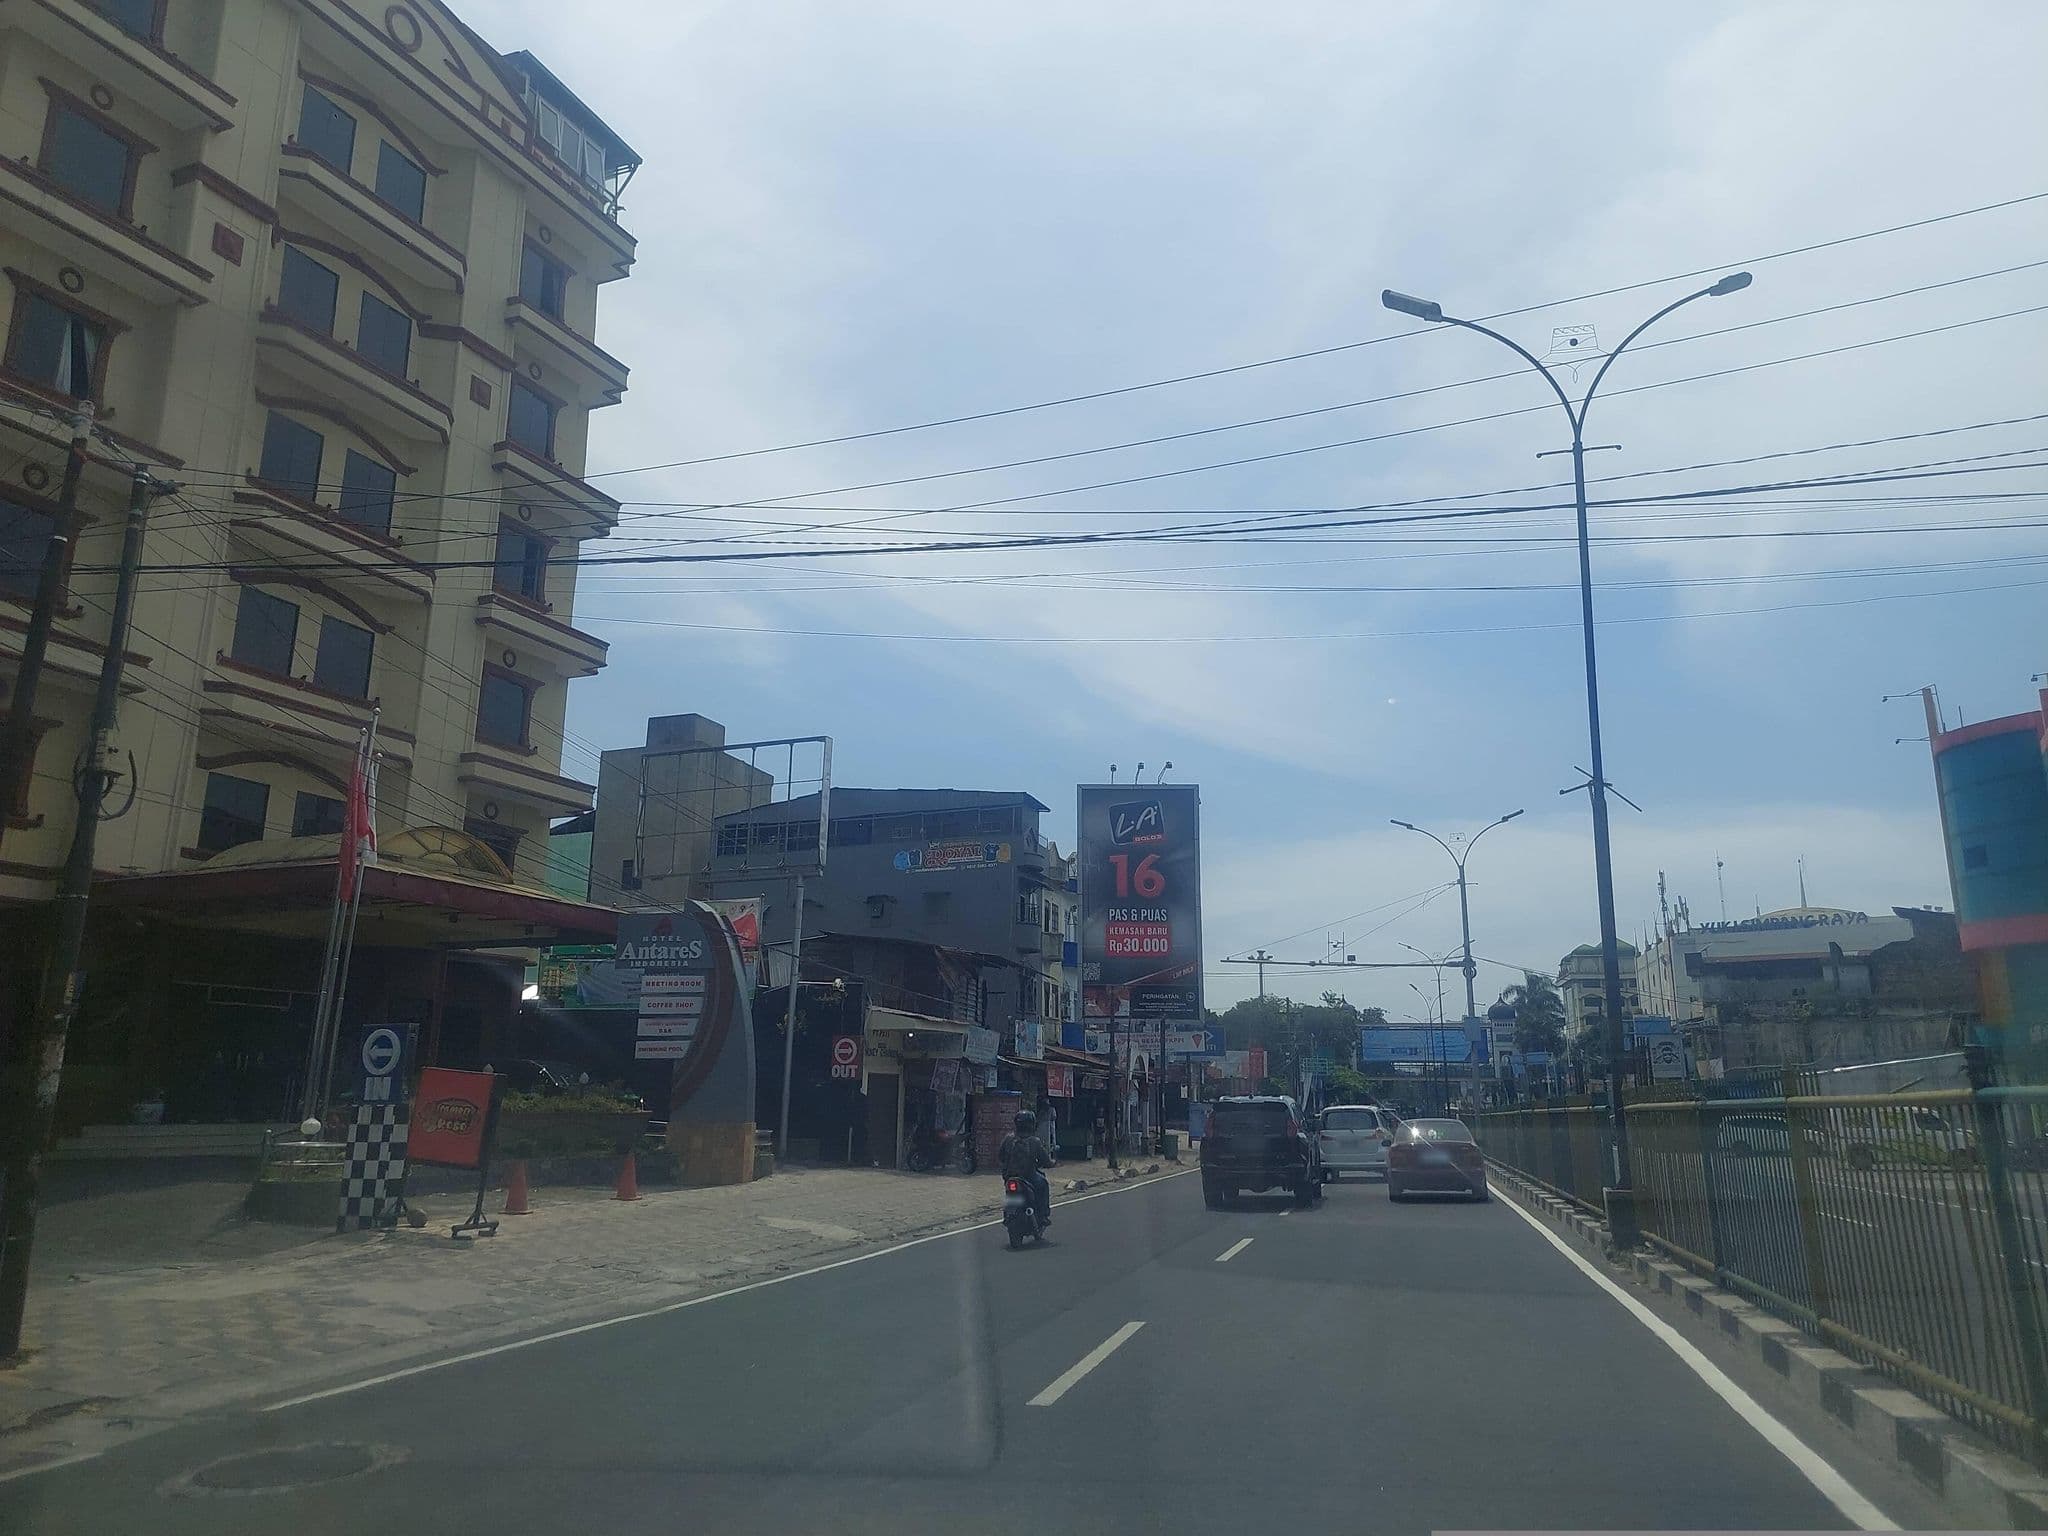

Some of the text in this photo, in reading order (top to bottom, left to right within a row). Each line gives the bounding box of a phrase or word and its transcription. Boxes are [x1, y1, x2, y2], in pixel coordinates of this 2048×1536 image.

[1109, 854, 1166, 897] 16
[1109, 908, 1167, 921] PAS & PUAS
[1818, 911, 1869, 927] RAYA
[1109, 927, 1168, 935] KEMASAN BARU
[831, 1064, 858, 1078] OUT
[363, 1076, 392, 1101] IN
